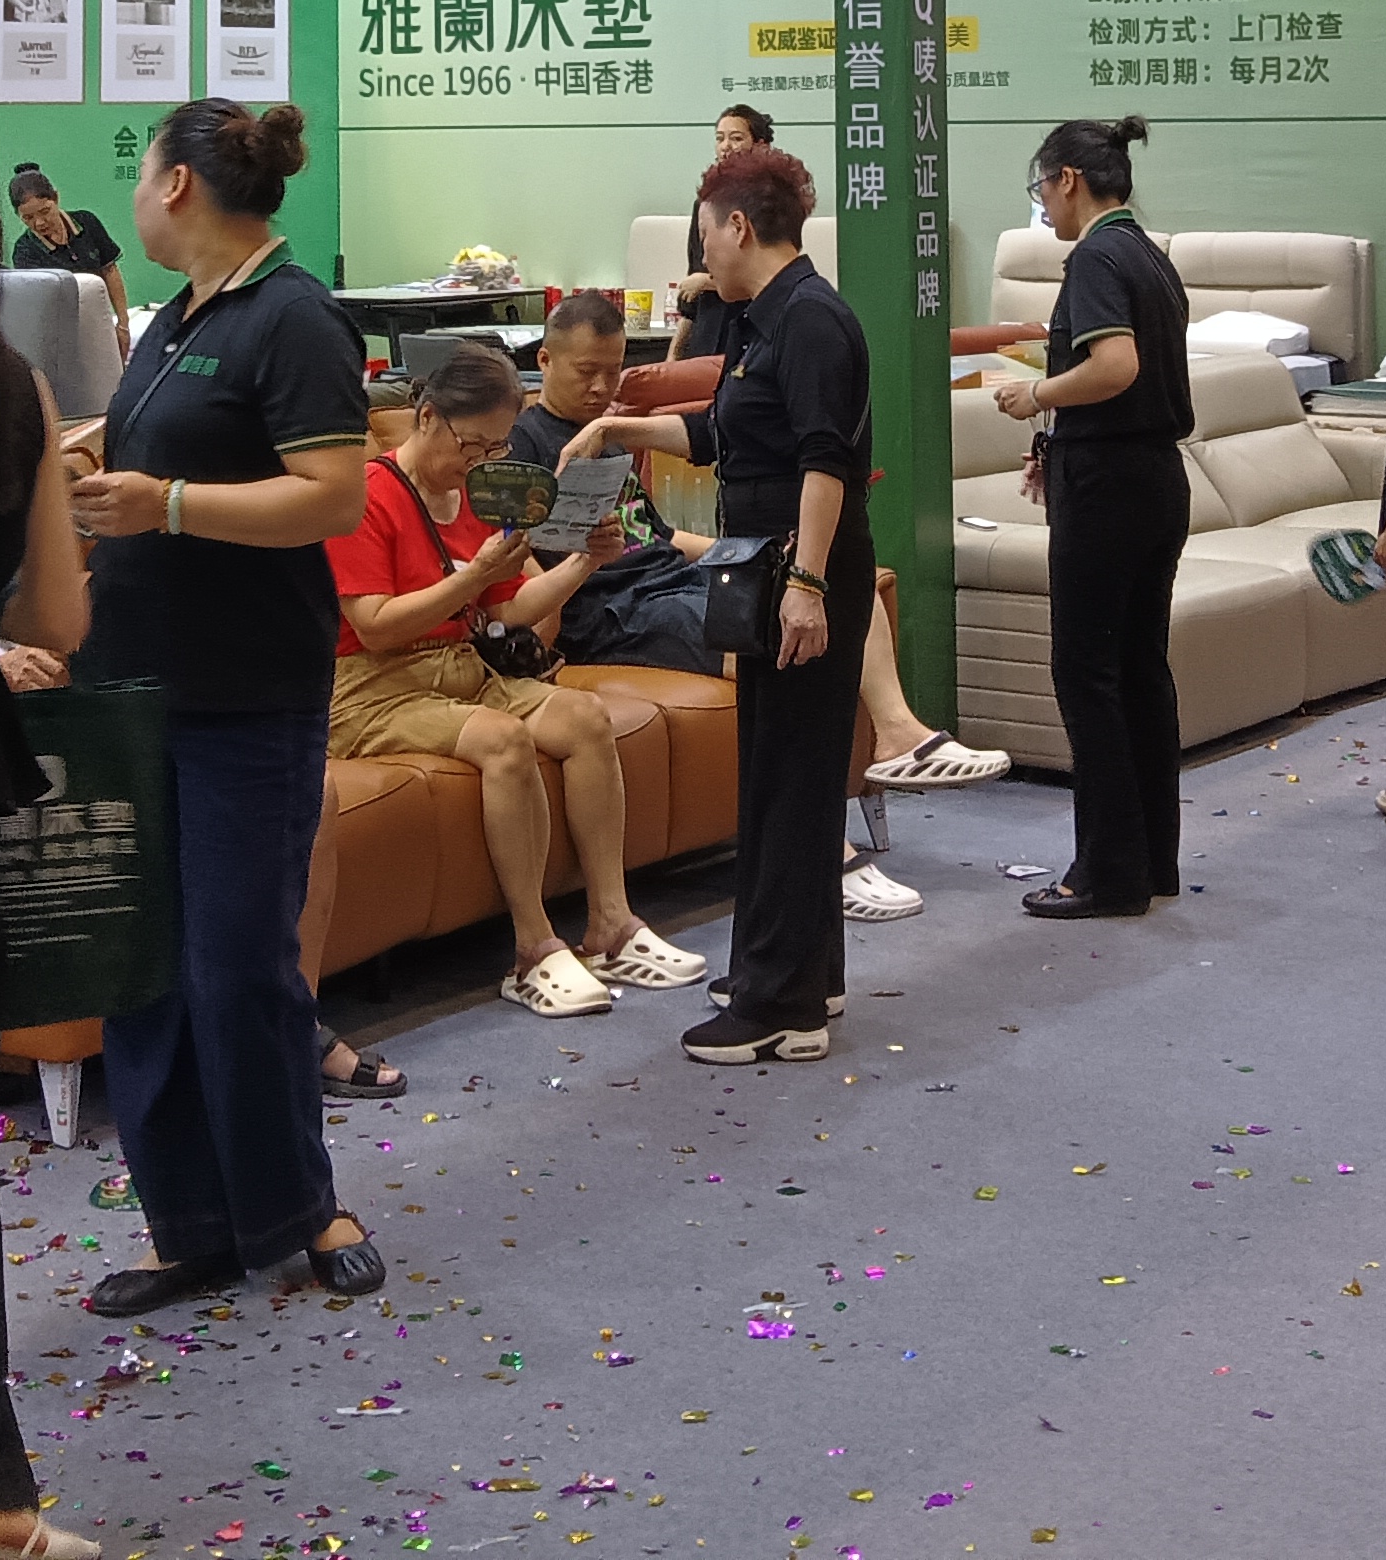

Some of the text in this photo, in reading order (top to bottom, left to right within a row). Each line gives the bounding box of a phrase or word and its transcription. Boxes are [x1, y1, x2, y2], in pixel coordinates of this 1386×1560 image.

[1088, 11, 1344, 46] 检测方式：上门检查
[358, 58, 654, 98] Since 1966 中国香港
[1089, 54, 1330, 87] 检测周期：每月2次
